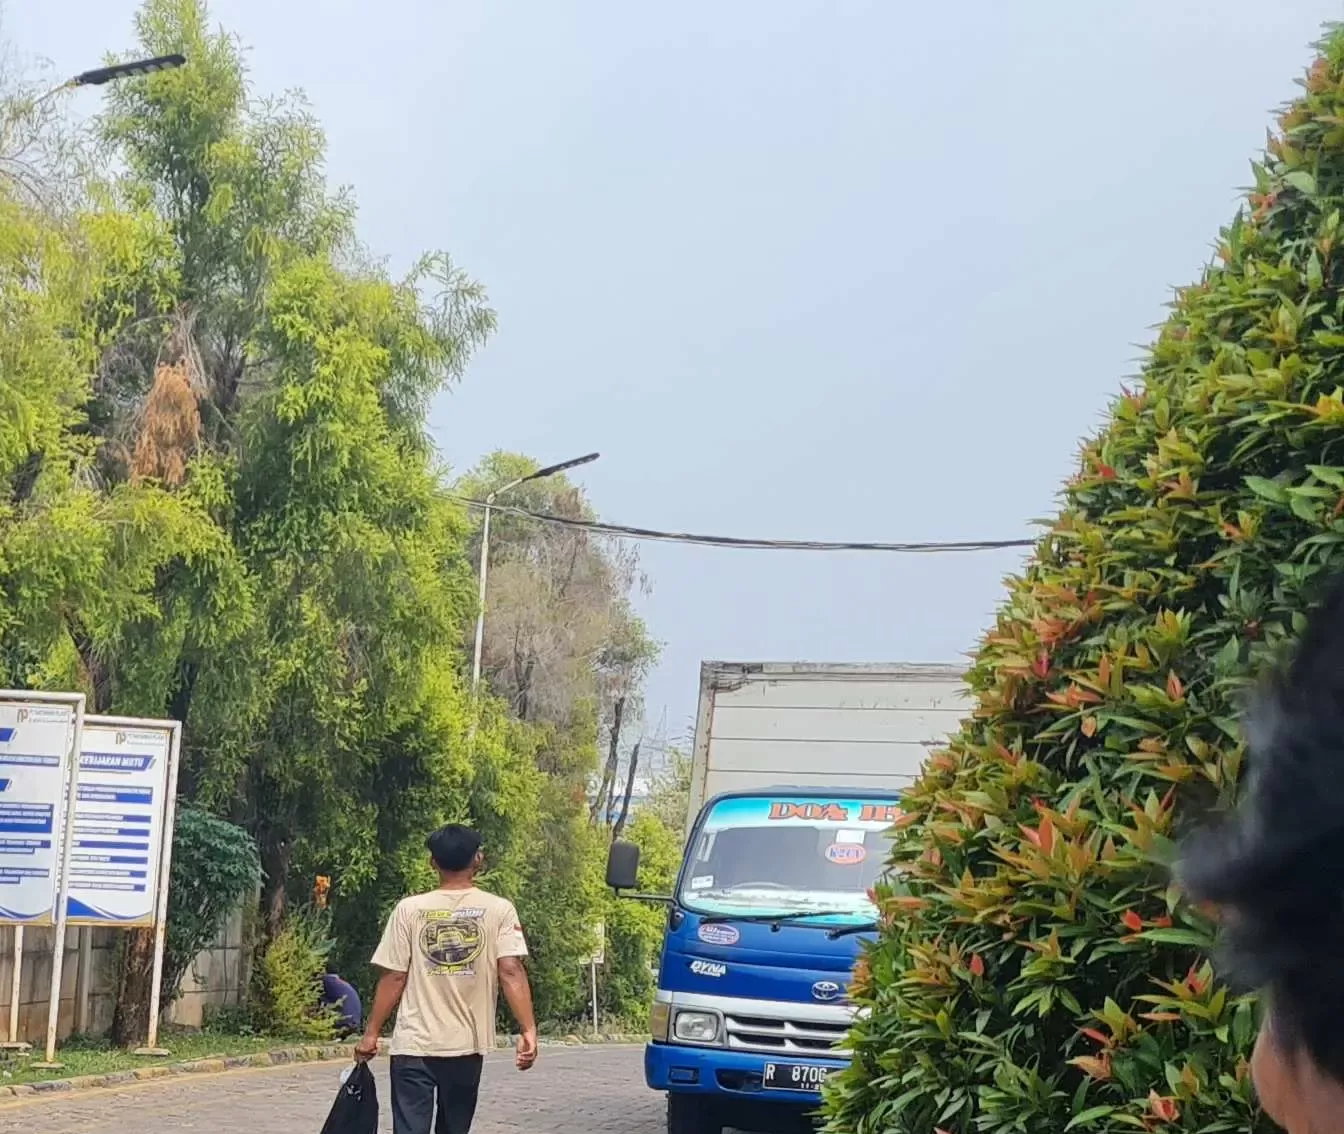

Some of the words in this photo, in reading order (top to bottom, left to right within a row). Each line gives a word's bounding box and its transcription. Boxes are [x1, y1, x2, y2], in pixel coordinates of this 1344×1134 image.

[768, 802, 848, 821] DOA
[690, 960, 726, 975] DYNA
[766, 1064, 776, 1081] R
